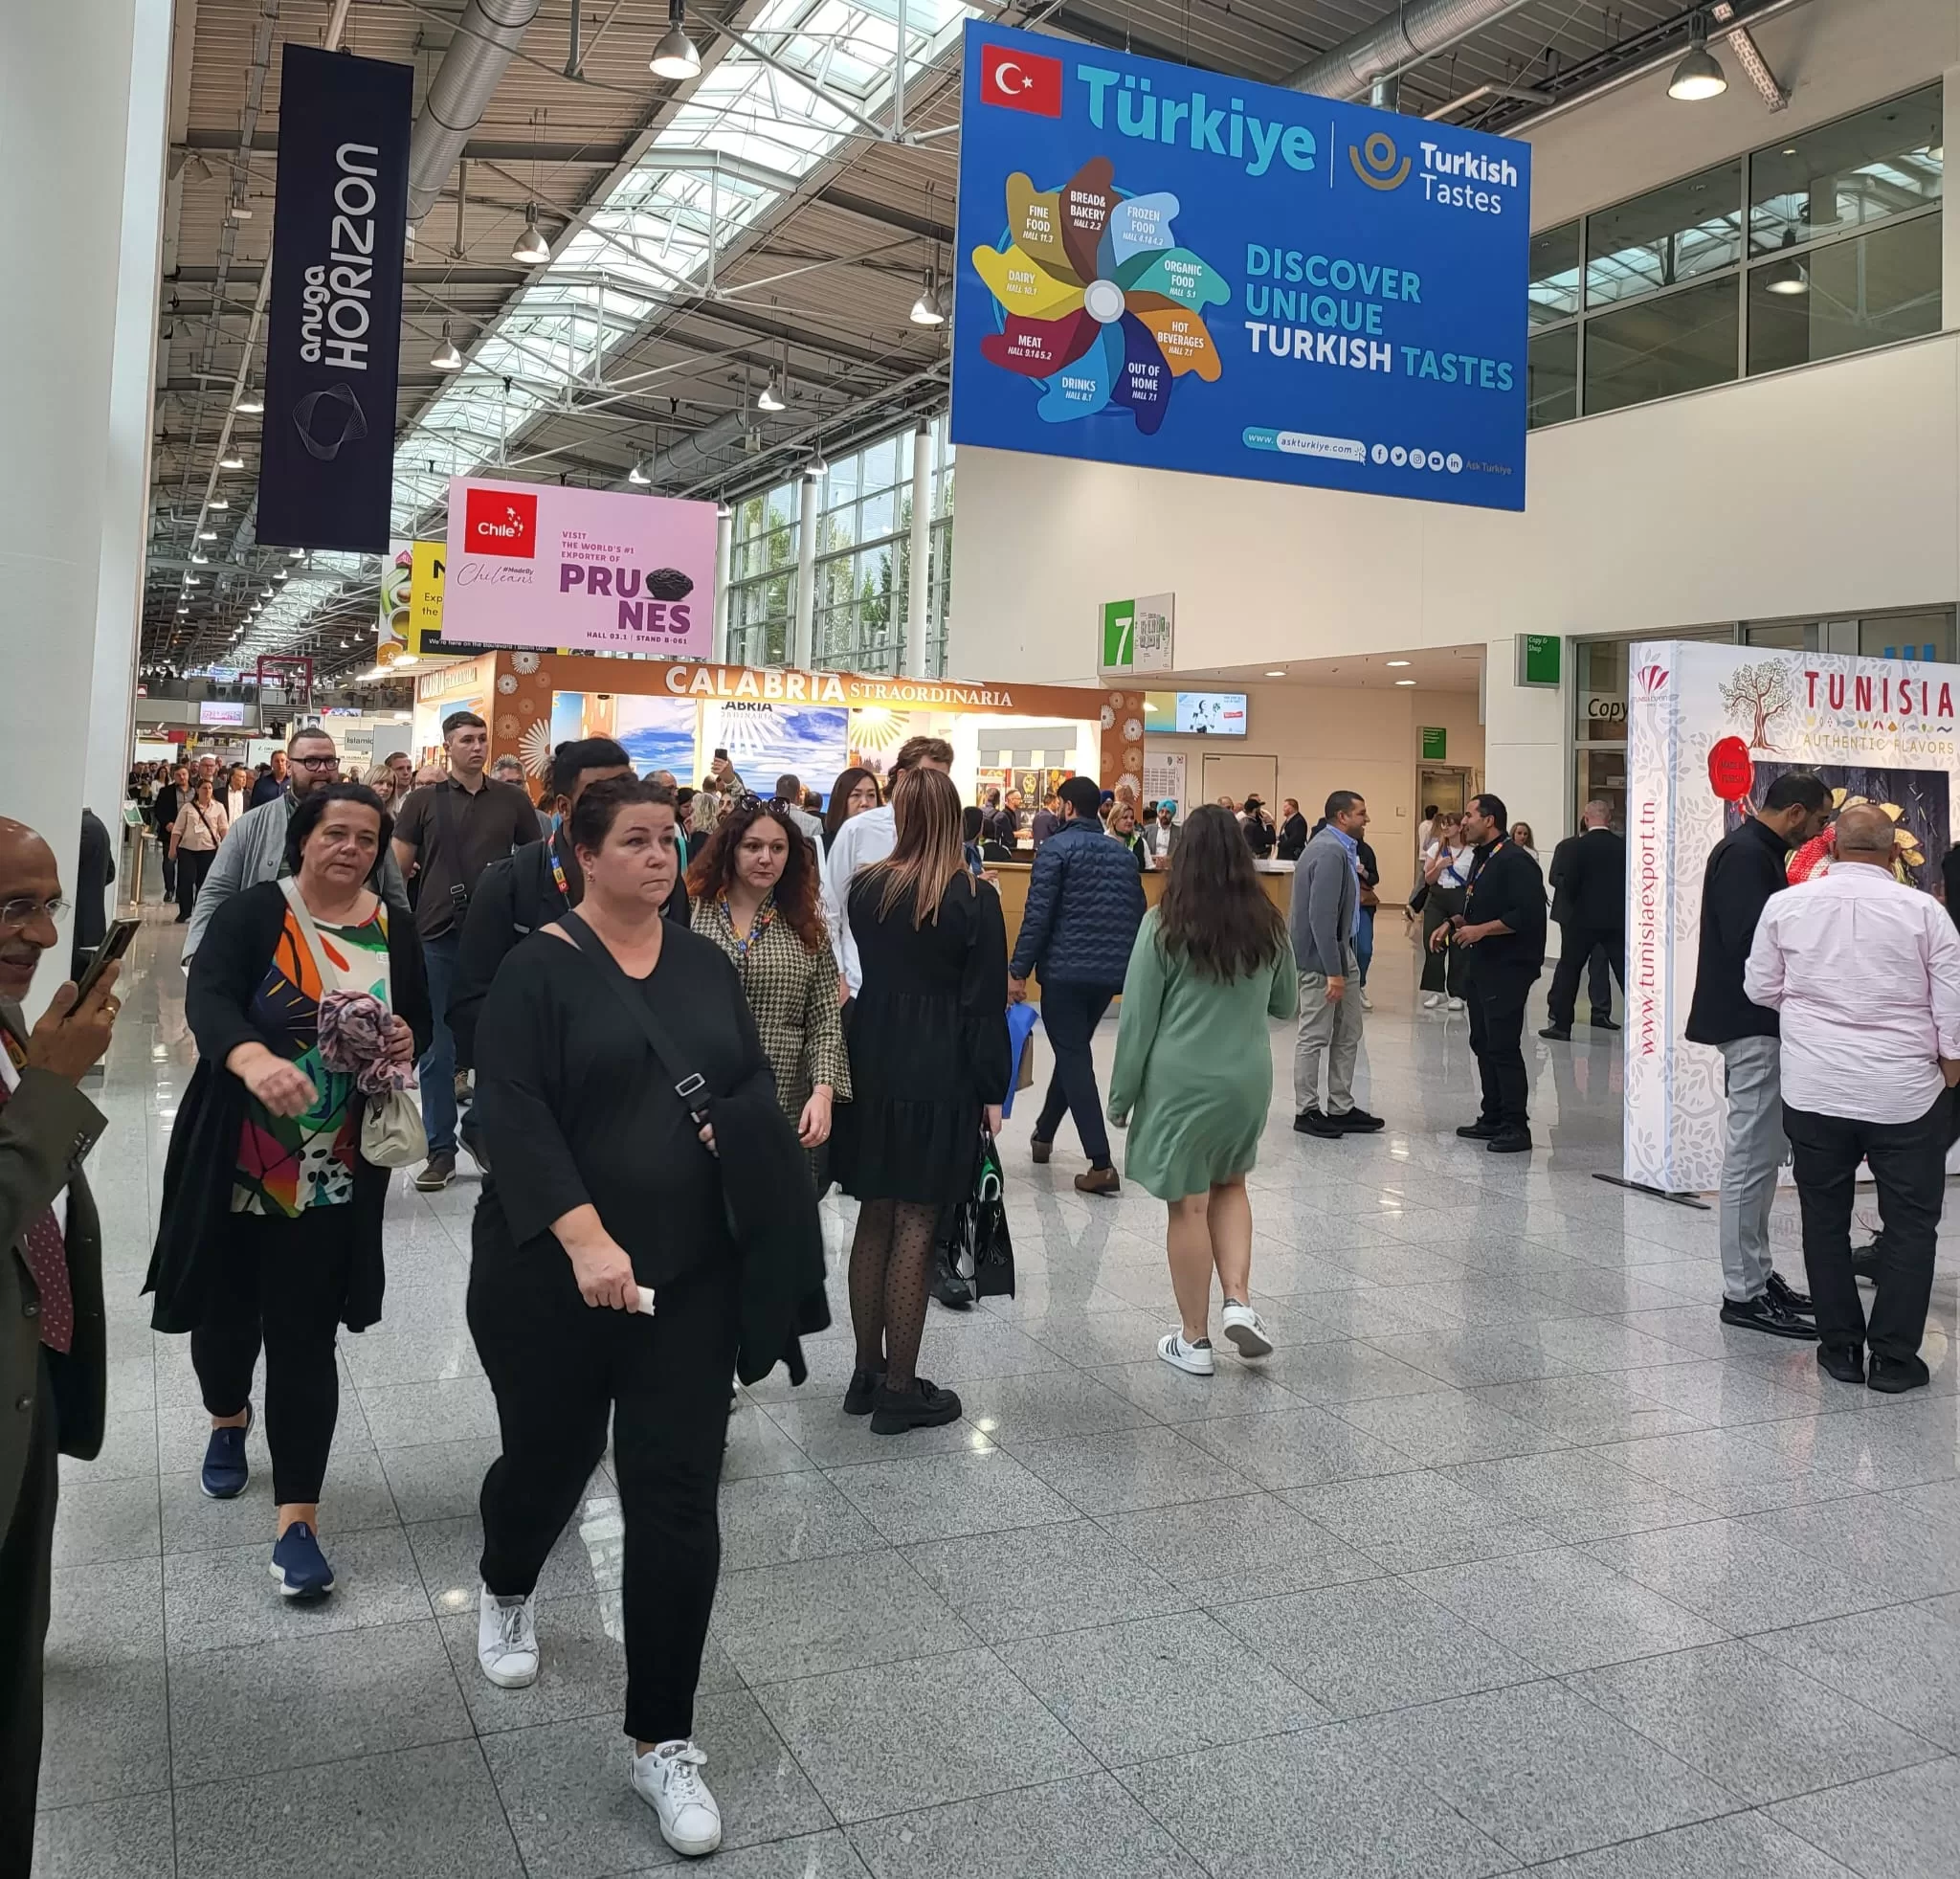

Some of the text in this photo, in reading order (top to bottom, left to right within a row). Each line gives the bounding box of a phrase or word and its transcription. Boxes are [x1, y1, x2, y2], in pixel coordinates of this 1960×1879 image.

[1078, 64, 1317, 176] Türkiye
[1420, 142, 1518, 187] Turkish
[1070, 190, 1106, 207] BREAD&
[1420, 172, 1502, 214] Tastes
[1029, 205, 1049, 219] FINE
[1070, 204, 1106, 221] BAKERY
[1127, 206, 1161, 222] FROZEN
[1026, 218, 1051, 233] FOOD
[1073, 218, 1102, 231] HALL 2.2
[1131, 220, 1155, 235] FOOD
[1022, 231, 1054, 243] HALL 11.3
[1123, 232, 1137, 242] HALL
[324, 142, 379, 370] HORIZON
[1164, 259, 1203, 277] ORGANIC
[1247, 243, 1422, 303] DISCOVER
[1008, 269, 1036, 284] DAIRY
[1170, 275, 1195, 288] FOOD
[1006, 282, 1037, 296] HALL 10.1
[1169, 286, 1196, 299] HALL 5.1
[300, 264, 331, 363] anuga
[1246, 283, 1384, 335] UNIQUE
[1171, 321, 1189, 334] HOT
[1018, 334, 1042, 348] MEAT
[1157, 331, 1204, 348] BEVERAGES
[1008, 346, 1023, 357] HALL
[1168, 346, 1193, 357] HALL 7.1
[1245, 321, 1514, 391] TURKISH TASTES
[1127, 362, 1160, 377] OUT OF
[1061, 376, 1096, 392] DRINKS
[1131, 376, 1158, 391] HOME
[1065, 390, 1093, 402] HALL 8.1
[1131, 391, 1157, 402] HALL 7.1
[1248, 434, 1352, 454] www. askturkiye.com
[1465, 459, 1481, 470] Ask
[478, 522, 516, 538] Chile
[562, 530, 587, 540] VISIT
[562, 541, 578, 549] THE
[581, 542, 621, 553] WORLD'S
[561, 550, 607, 562] EXPORTER
[457, 563, 534, 586] Chileans
[560, 563, 641, 598] PRU
[422, 607, 438, 615] the
[618, 600, 691, 635] NES
[587, 631, 607, 639] HALL
[635, 635, 661, 643] STAND
[1114, 616, 1133, 666] 7
[1528, 636, 1543, 645] Copy
[1528, 644, 1542, 654] Shop
[665, 665, 1013, 707] CALABRIA STRAORDINARIA
[1804, 670, 1954, 718] TUNISIA
[1588, 698, 1629, 723] Copy
[1803, 733, 1954, 754] AUTHENTIC FLAVORS
[1637, 801, 1660, 1056] www.tunisiaexport.tn
